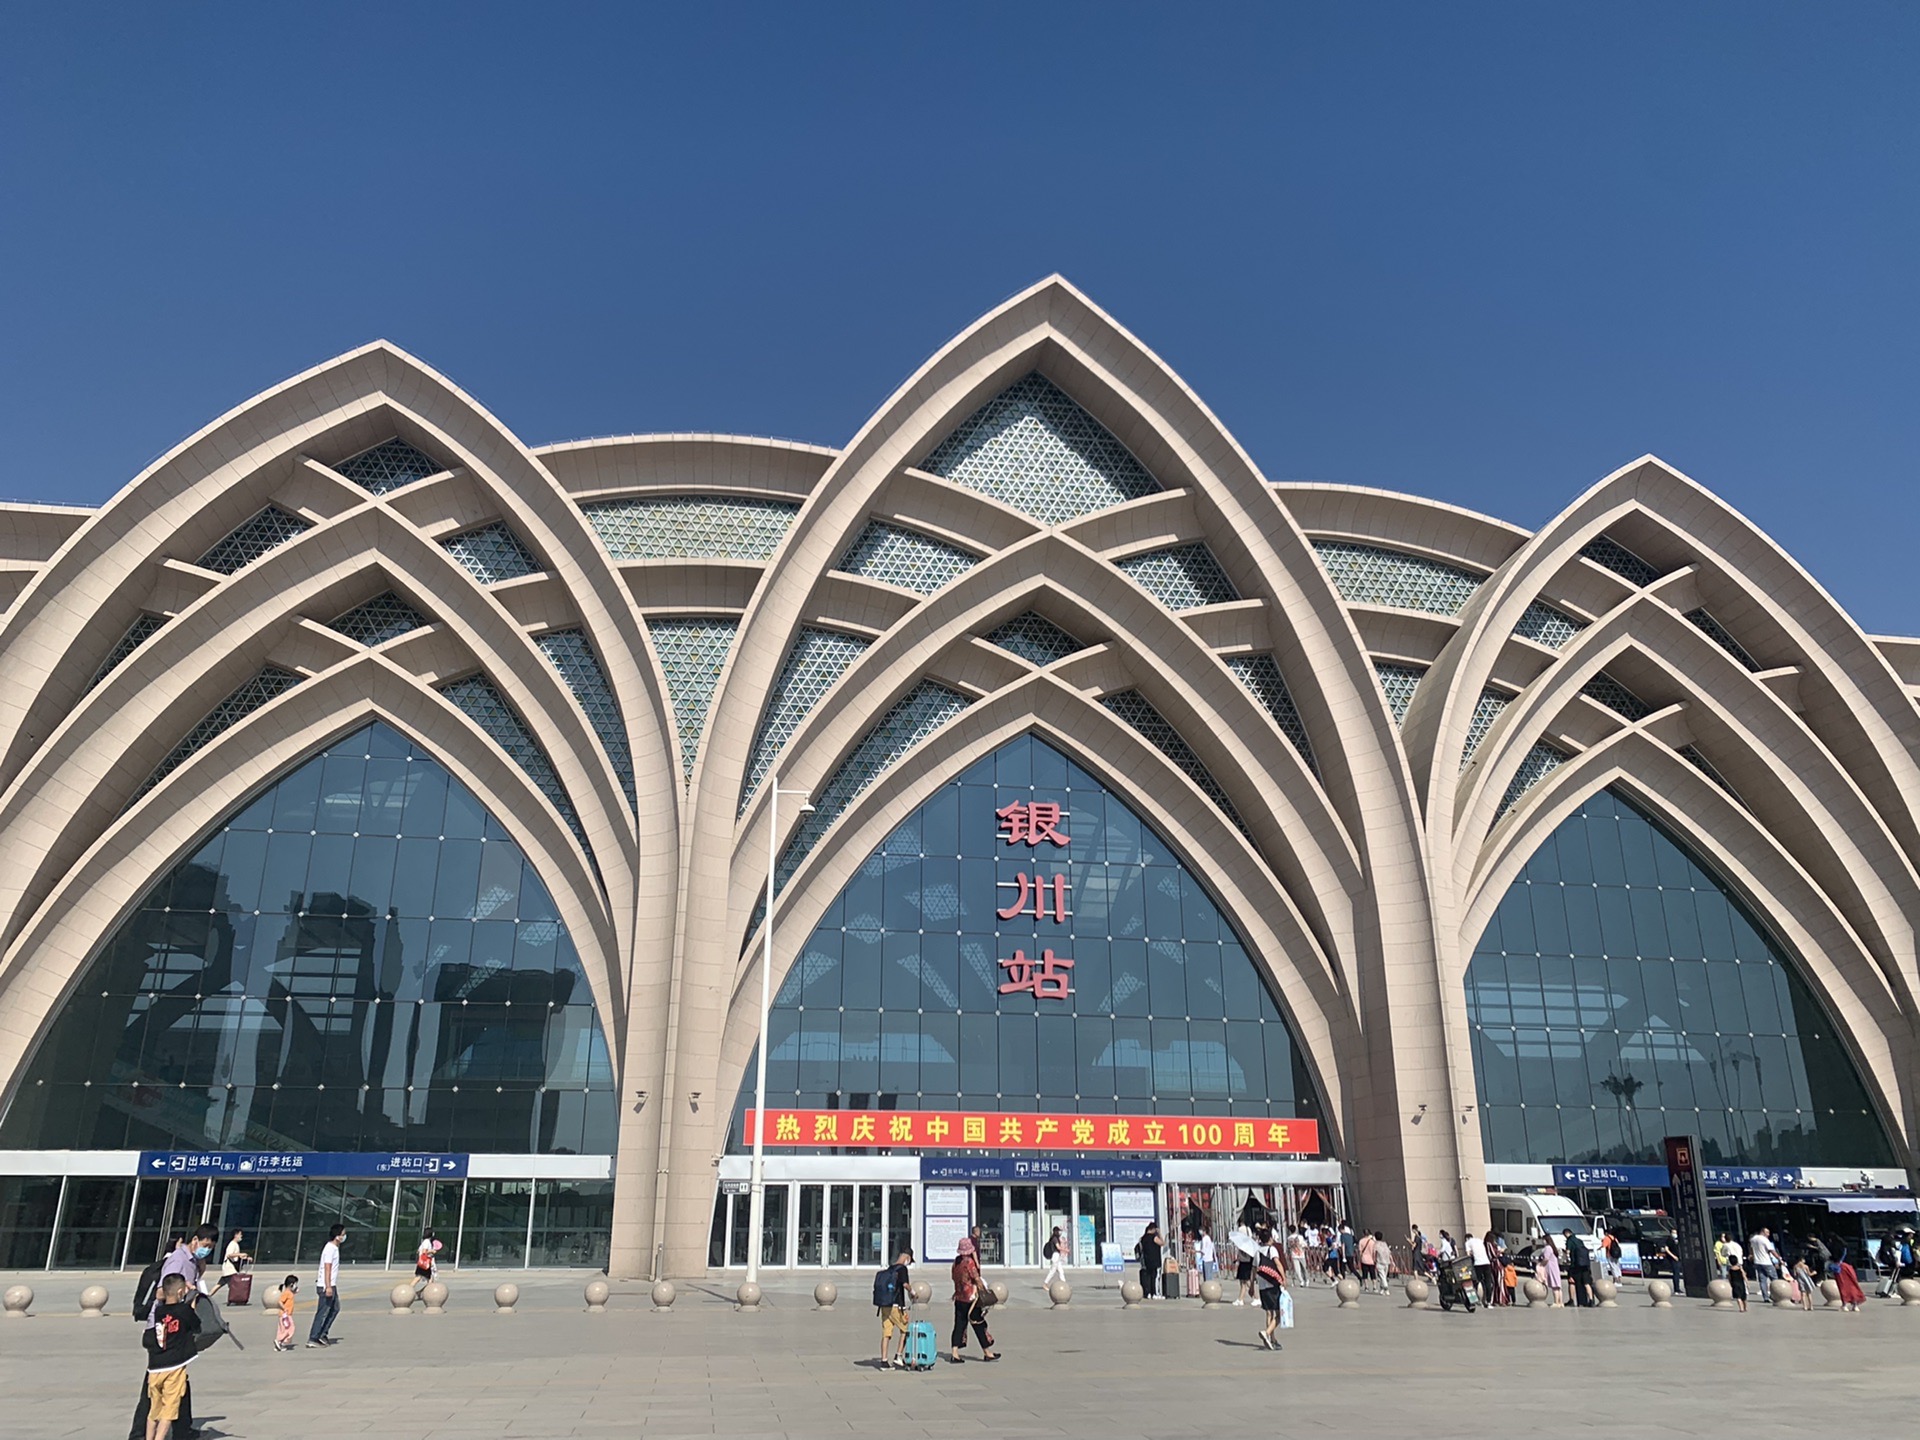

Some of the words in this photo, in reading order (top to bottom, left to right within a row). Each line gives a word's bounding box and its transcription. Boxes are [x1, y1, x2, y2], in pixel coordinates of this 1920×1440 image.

[996, 800, 1075, 999] 银川站
[776, 1114, 1291, 1148] 热烈庆祝中国共产党成立100周年
[187, 1156, 222, 1167] 出站口
[257, 1156, 303, 1167] 行李托运
[391, 1157, 422, 1168] 进站口
[1031, 1162, 1059, 1172] 进站口
[1592, 1169, 1617, 1178] 进站口
